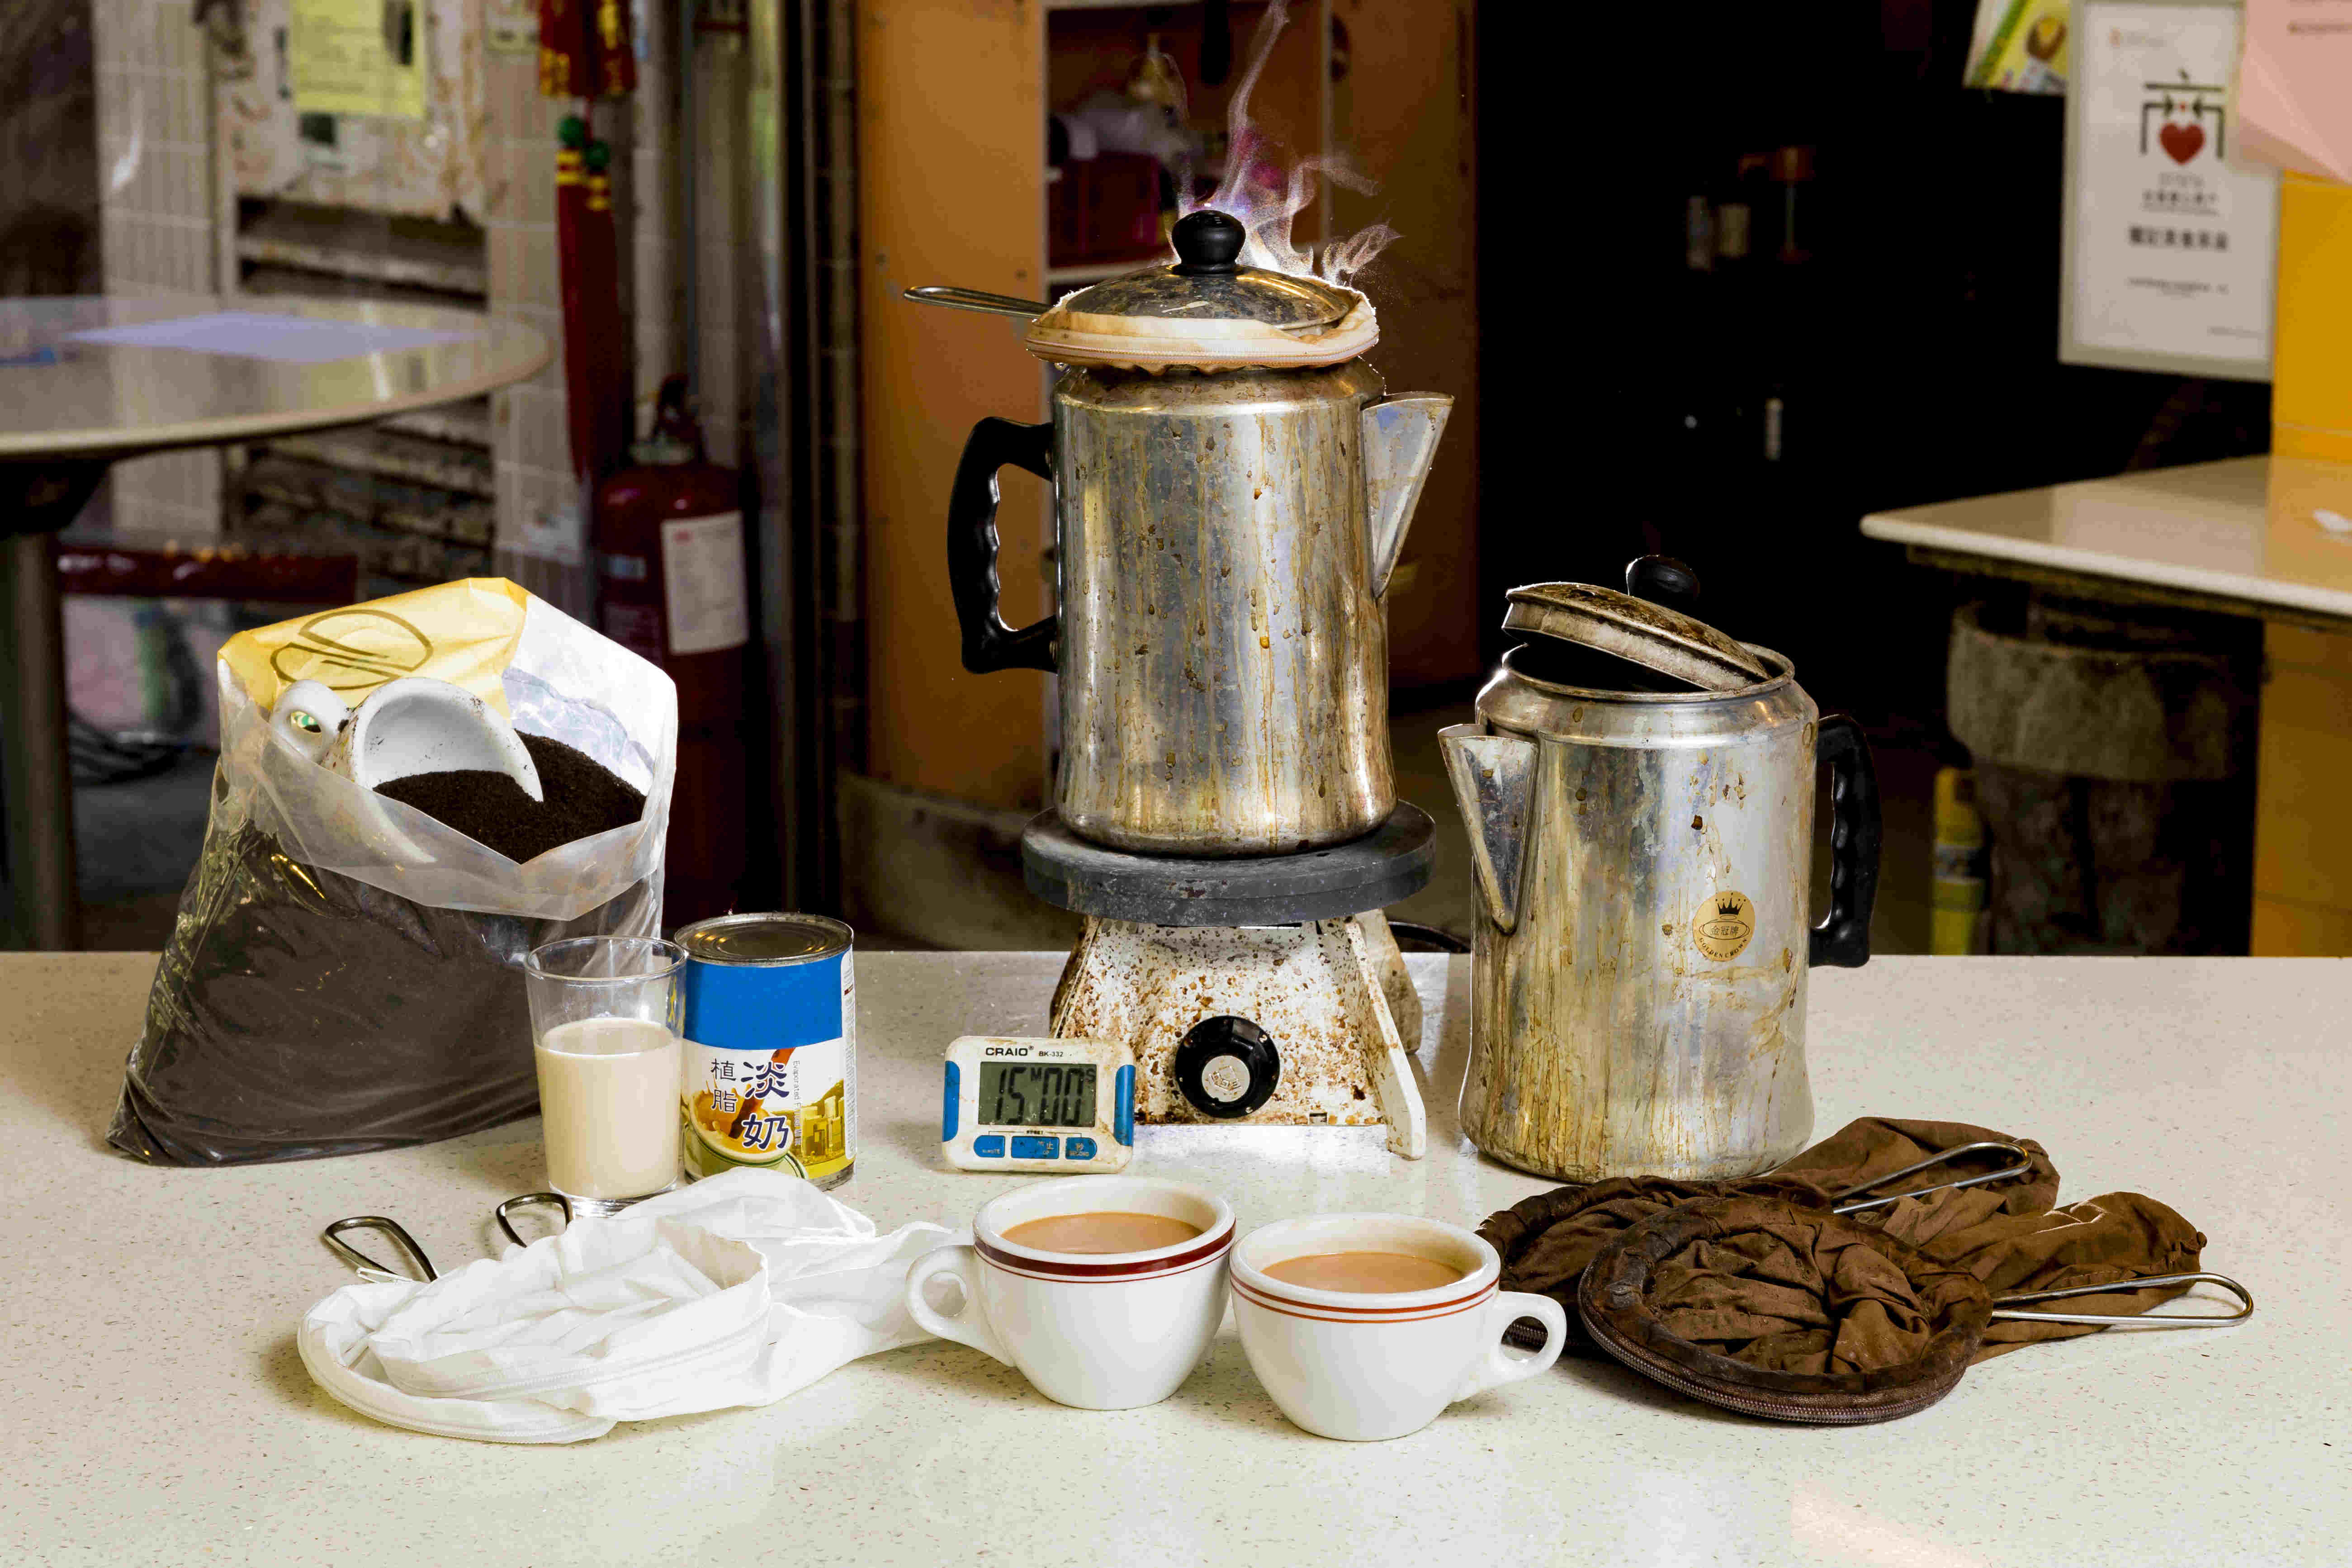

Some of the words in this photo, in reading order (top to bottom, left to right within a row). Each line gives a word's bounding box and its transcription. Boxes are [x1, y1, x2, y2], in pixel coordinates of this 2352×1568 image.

[1699, 938, 1723, 958] GOLDEN
[1725, 938, 1748, 958] CROWN
[710, 1057, 738, 1114] 植脂
[740, 1061, 790, 1151] 淡奶
